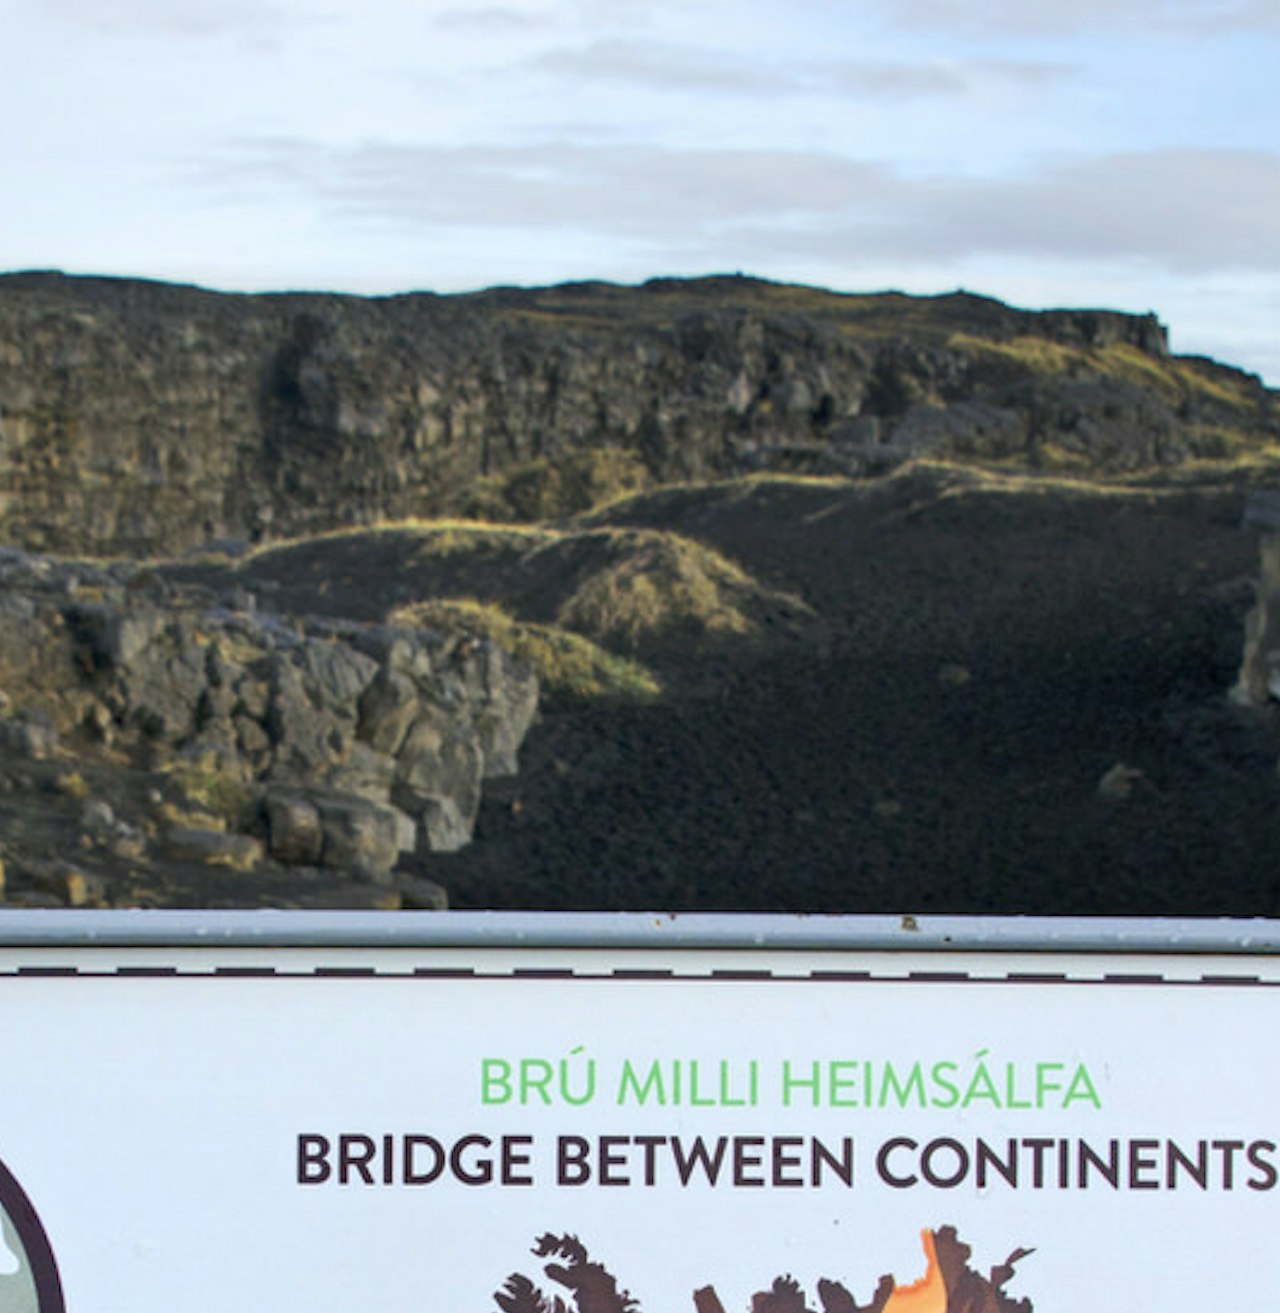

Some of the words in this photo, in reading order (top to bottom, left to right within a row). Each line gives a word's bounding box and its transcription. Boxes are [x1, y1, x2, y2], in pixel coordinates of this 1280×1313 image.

[479, 1044, 598, 1108] BRÚ
[615, 1058, 760, 1108] MILLI
[781, 1047, 1103, 1111] HEIMSÁLFA
[297, 1133, 533, 1186] BRIDGE
[557, 1135, 853, 1188] BETWEEN
[876, 1137, 1278, 1191] CONTINENTS
